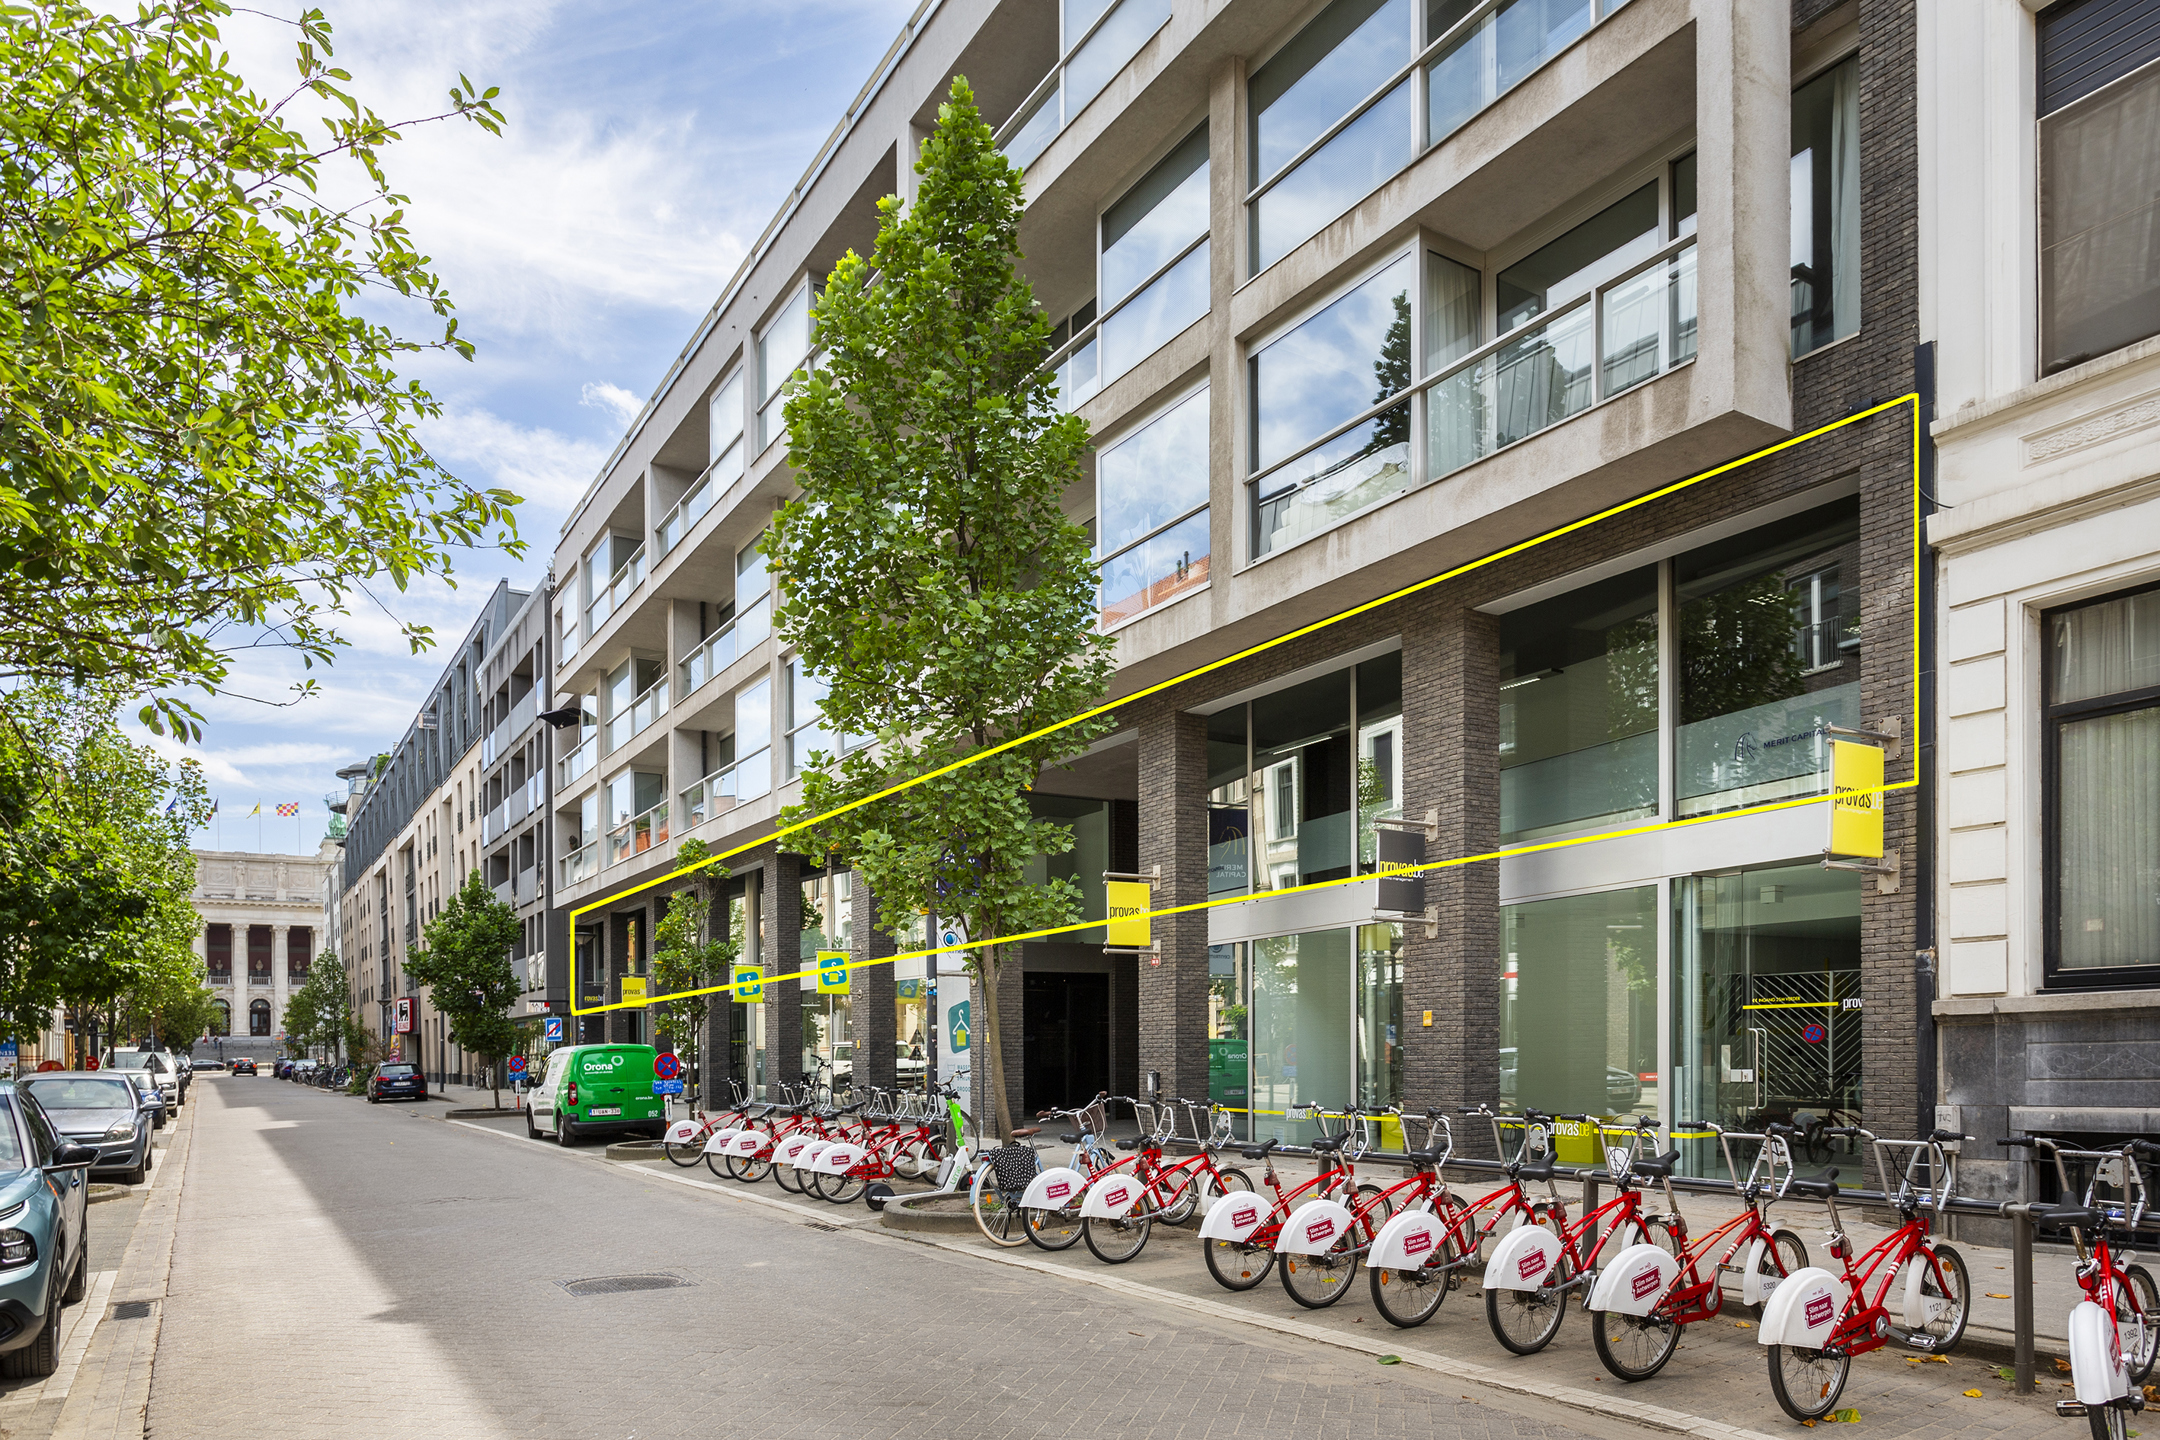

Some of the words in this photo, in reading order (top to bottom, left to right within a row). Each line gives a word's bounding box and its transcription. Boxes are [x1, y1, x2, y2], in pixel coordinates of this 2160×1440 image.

[1763, 737, 1789, 748] MERIT
[1791, 727, 1827, 742] CAPITAL
[1236, 1216, 1255, 1224] Antwerpen
[1311, 1227, 1332, 1239] Antwerpen
[1408, 1240, 1429, 1250] Antwerpen
[1531, 1256, 1540, 1264] naar
[1523, 1260, 1544, 1274] Antwerpen
[1635, 1279, 1645, 1288] Slim
[1645, 1274, 1655, 1283] naar
[1636, 1279, 1658, 1294] Antwerpen
[1809, 1305, 1819, 1314] Slim
[1819, 1302, 1828, 1310] naar
[1929, 1302, 1942, 1312] 1121
[1810, 1308, 1831, 1321] Antwerpen
[2124, 1327, 2138, 1340] 1392
